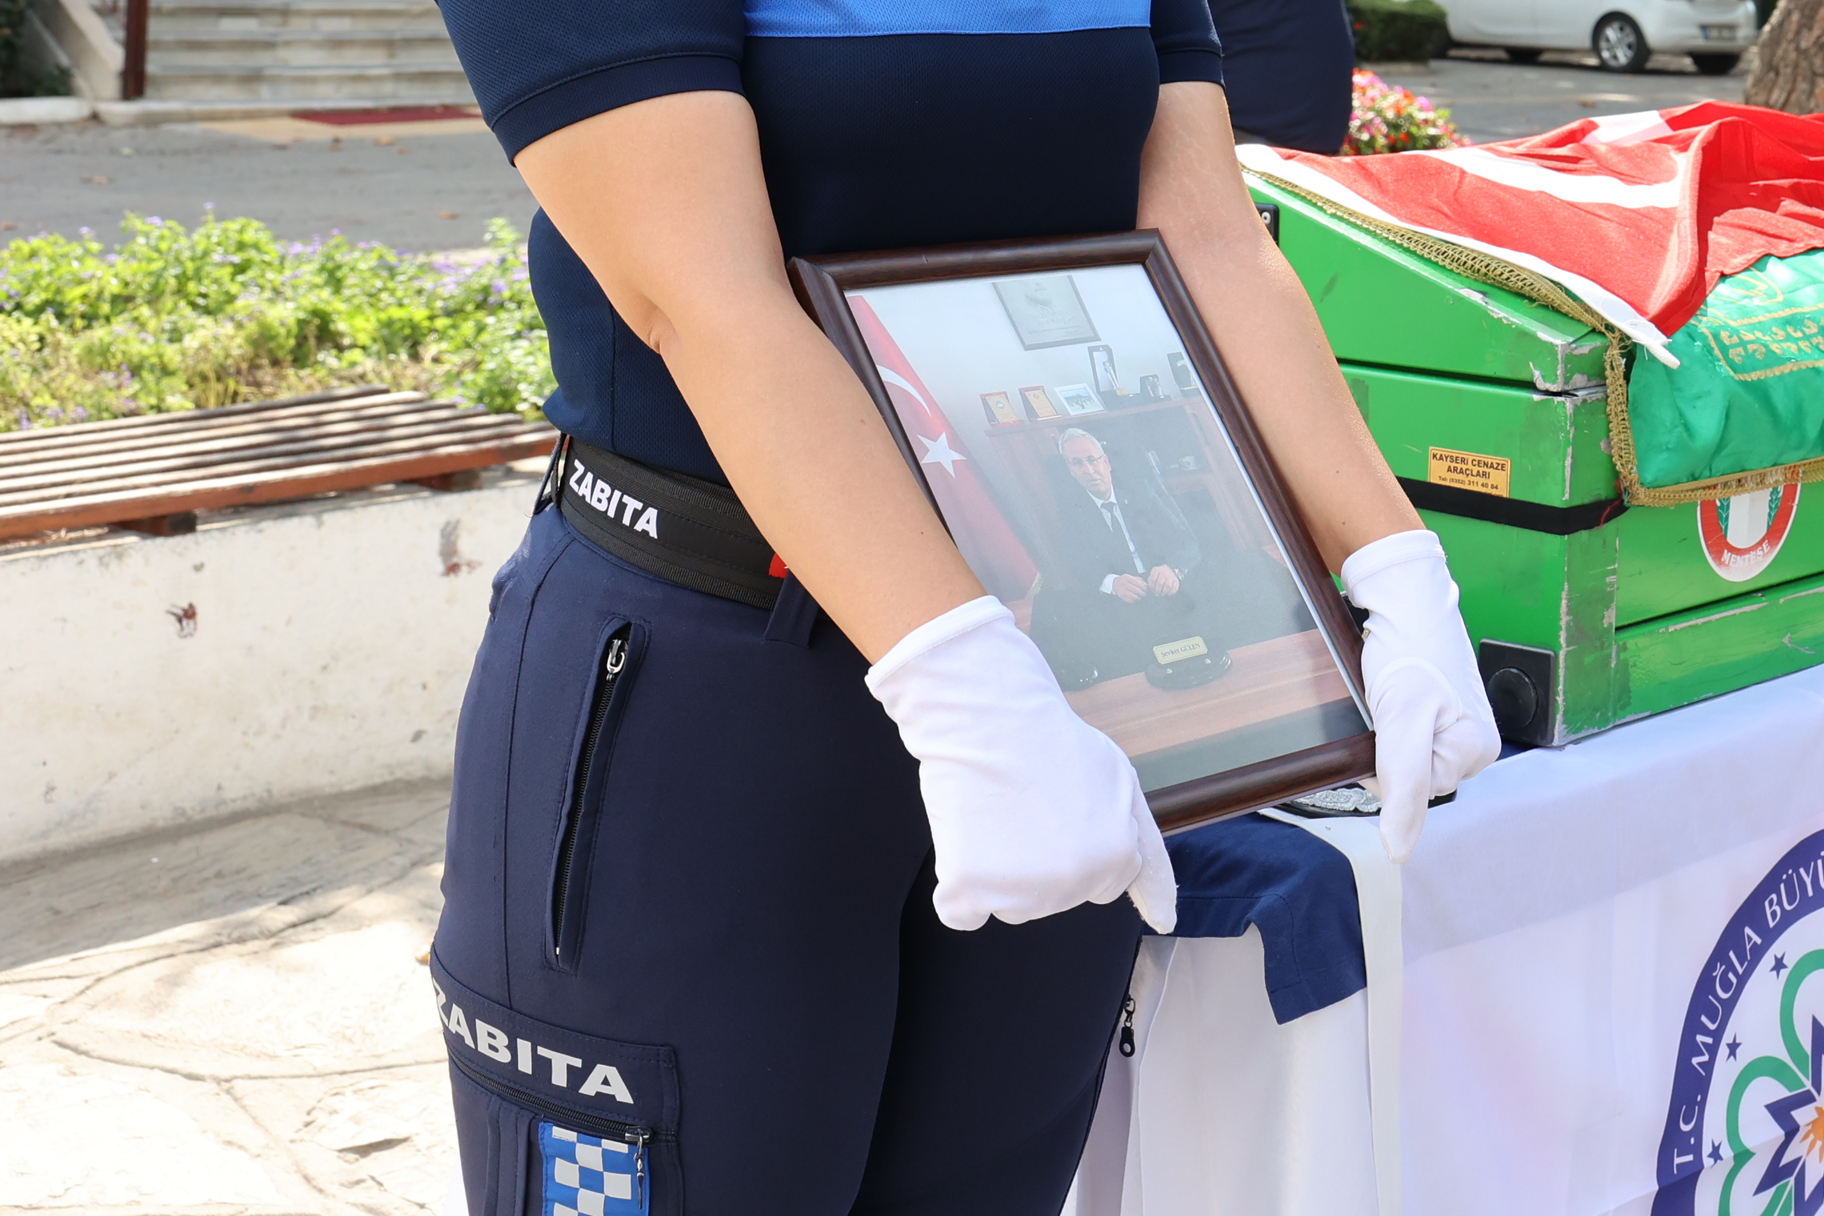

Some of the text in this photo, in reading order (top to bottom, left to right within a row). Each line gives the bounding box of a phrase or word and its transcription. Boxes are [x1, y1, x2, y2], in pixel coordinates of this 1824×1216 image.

[1446, 465, 1491, 479] ARAÇLARI
[1467, 479, 1479, 487] 311
[1471, 458, 1507, 472] CENAZE
[569, 458, 659, 540] ZABITA
[432, 976, 634, 1104] ZABITA
[1673, 1094, 1702, 1174] T.C.
[1691, 924, 1763, 1077] MUĞLA
